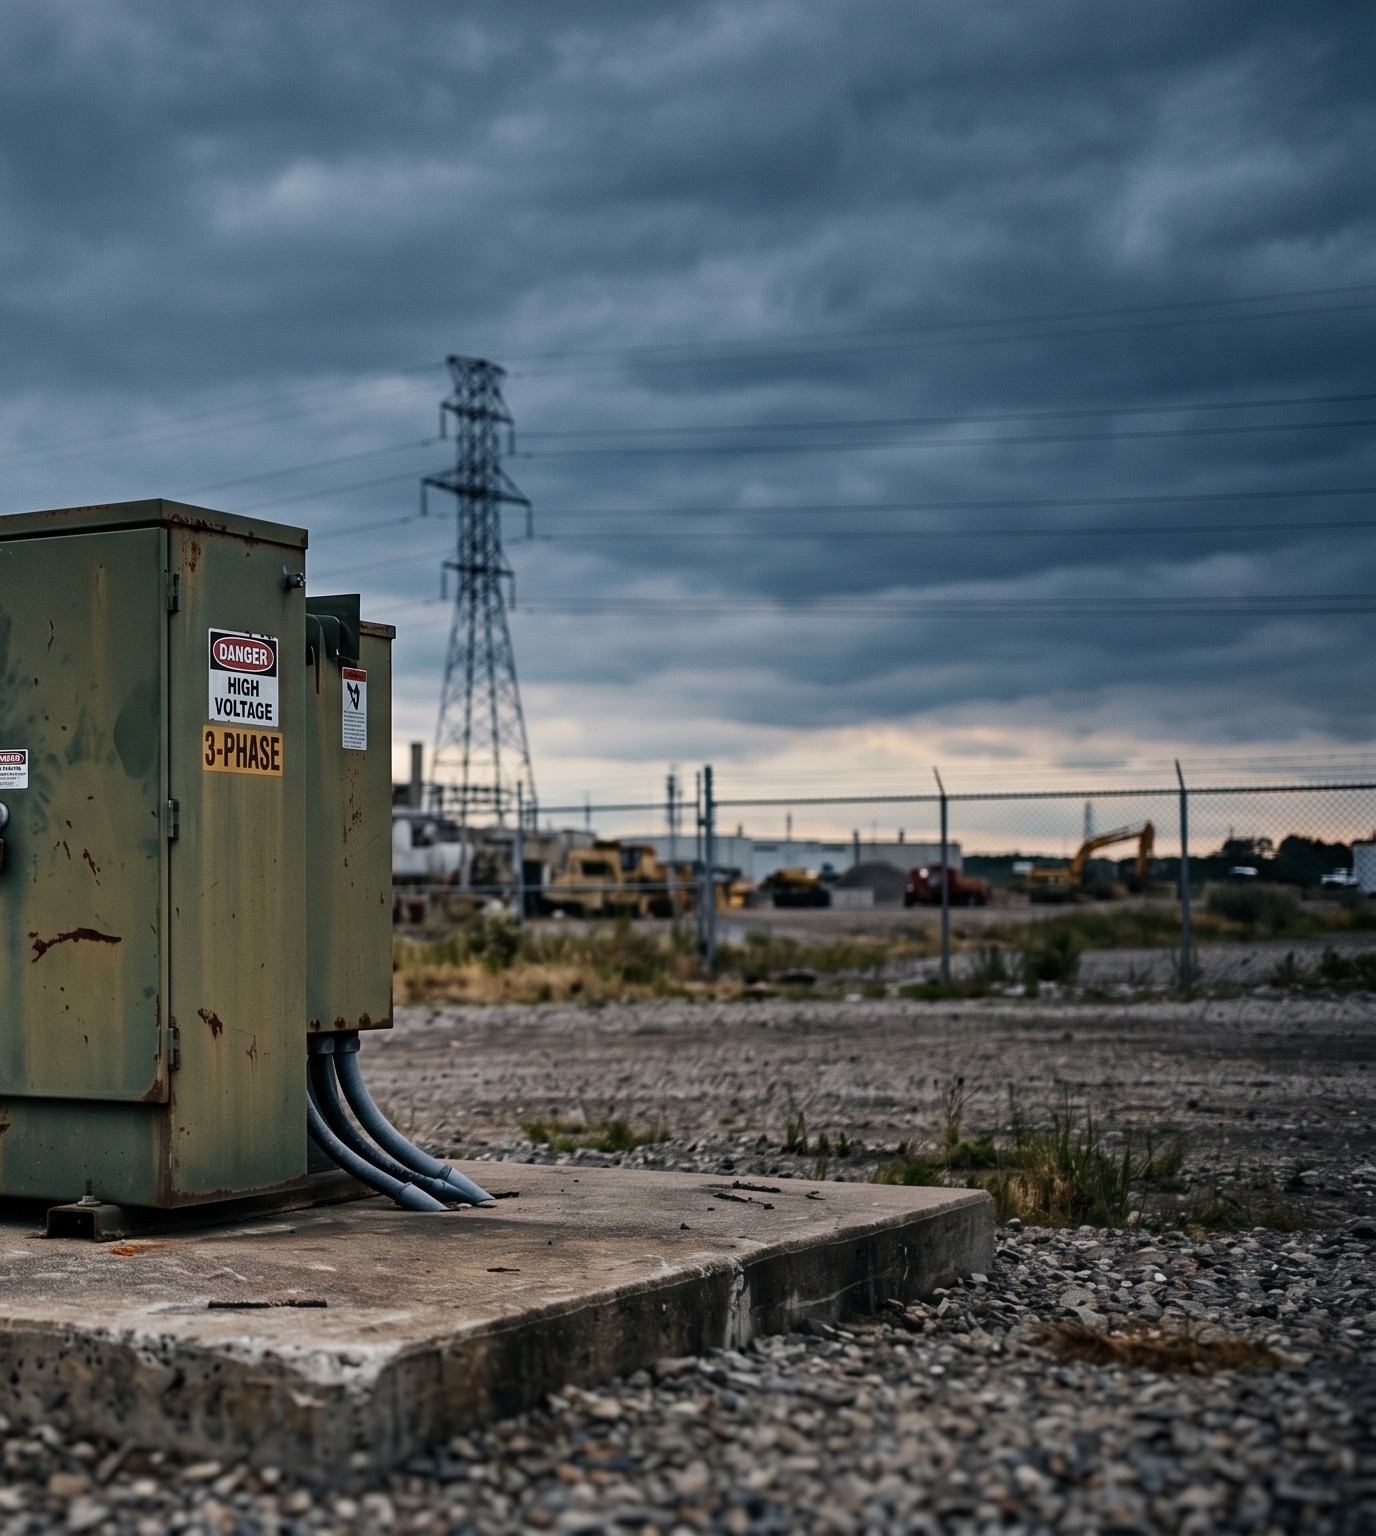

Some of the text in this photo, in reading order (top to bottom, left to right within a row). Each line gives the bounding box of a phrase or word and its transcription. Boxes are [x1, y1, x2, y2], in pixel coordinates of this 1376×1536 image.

[219, 643, 268, 666] DANGER
[228, 676, 259, 698] HIGH
[215, 697, 273, 721] VOLTAGE
[205, 730, 280, 771] 3-PHASE
